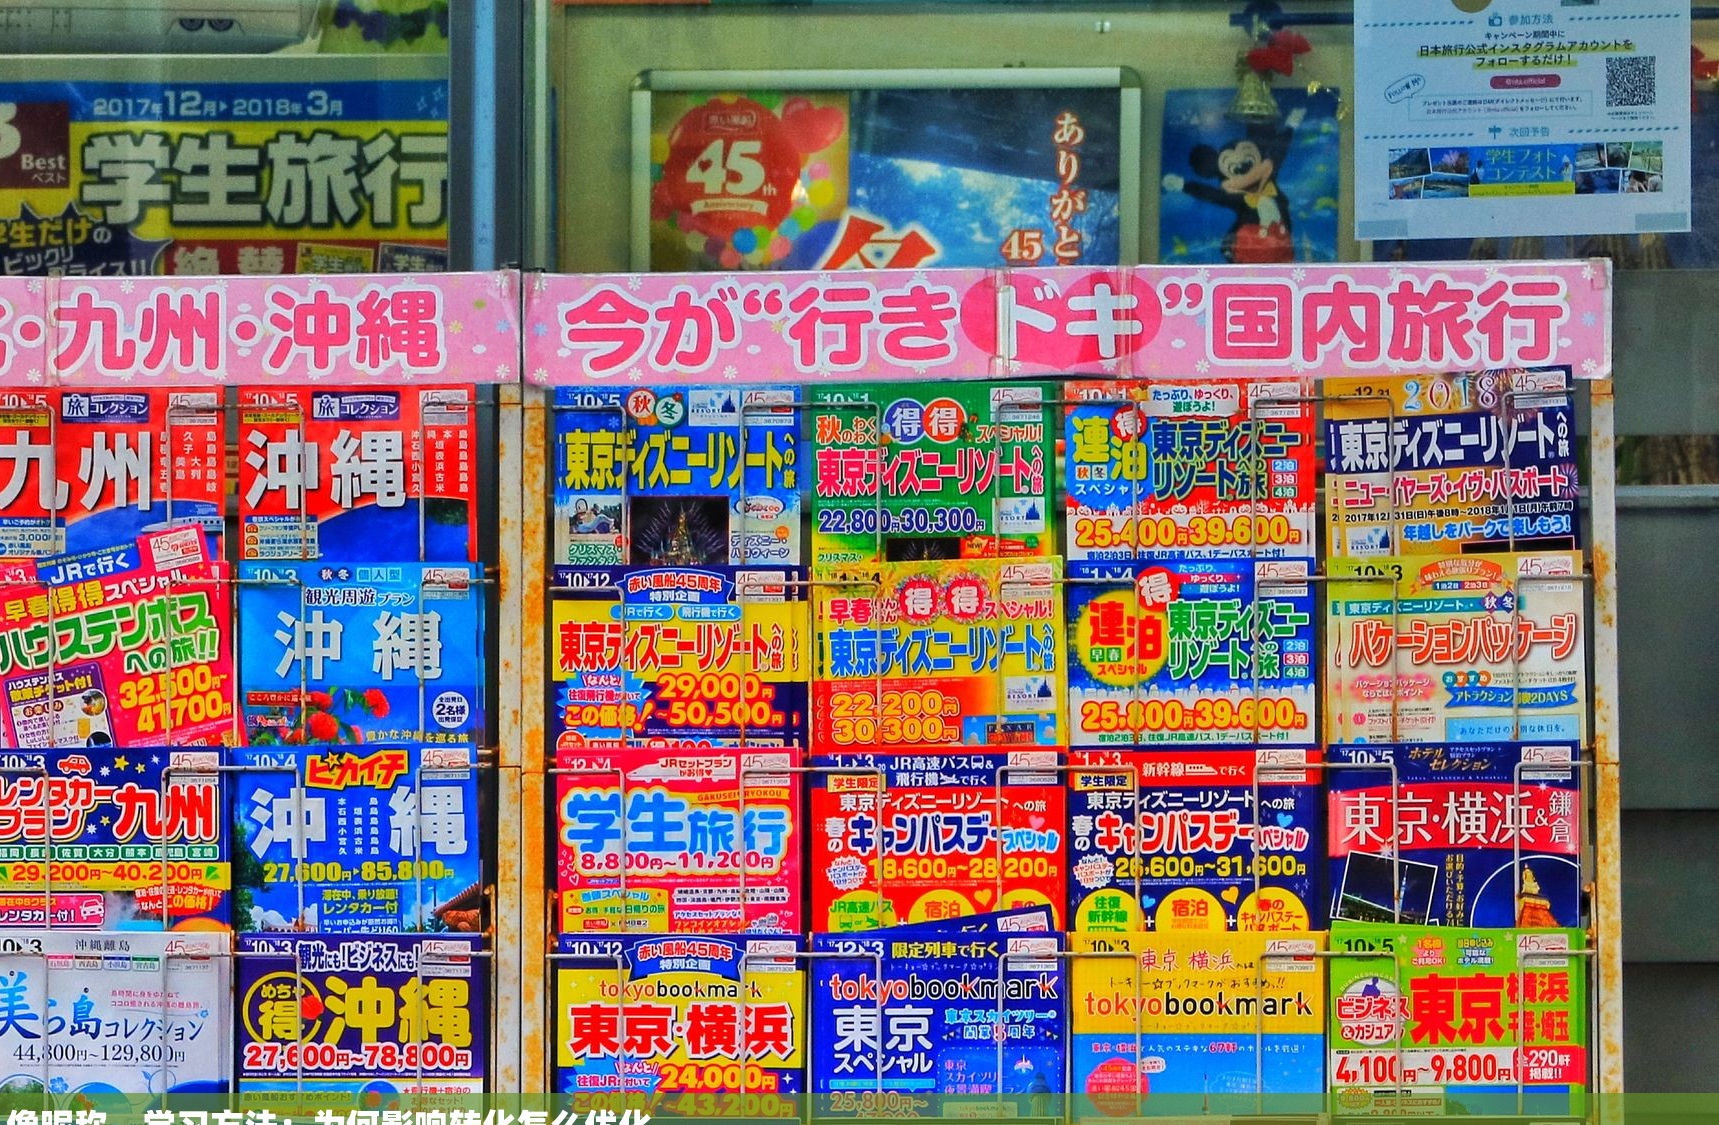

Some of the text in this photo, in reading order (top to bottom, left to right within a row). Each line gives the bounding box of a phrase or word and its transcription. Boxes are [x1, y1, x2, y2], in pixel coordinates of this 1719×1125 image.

[1509, 13, 1554, 25] 参加方法
[1485, 30, 1565, 39] キャンペーン期間中に
[1418, 39, 1633, 57] 日本旅行公式インスタグラムアカウントを
[94, 92, 342, 118] 2017年12月 2018年3月
[1509, 127, 1550, 137] 次回予告
[21, 153, 66, 171] Best
[1486, 148, 1557, 163] 学生フォト
[32, 172, 68, 184] ベスト
[82, 132, 447, 228] 学生旅行
[1487, 165, 1557, 181] コンテスト
[1003, 231, 1043, 260] 45
[4, 246, 75, 275] ビックリ
[1172, 401, 1216, 413] 遊ぼうよ!
[1151, 420, 1301, 459] 東京ディズニー
[245, 430, 407, 510] 沖縄
[564, 430, 783, 491] 東京ディズニーリゾート
[816, 445, 1030, 498] 東京ディズニーリゾート
[1153, 459, 1235, 500] リゾート
[50, 554, 130, 583] JRで行く
[627, 573, 722, 593] 赤い風船45周年
[649, 591, 700, 603] 特別企画
[275, 610, 443, 681] 沖縄
[559, 622, 770, 673] 東京ディズニーリゾート
[1349, 614, 1576, 667] バケーションパッケージ
[658, 673, 774, 700] 29,000円
[305, 751, 409, 790] ピカイチ
[660, 756, 734, 770] JRセットプラン
[1428, 756, 1494, 772] セレクション
[744, 789, 781, 797] RYOKOU
[833, 777, 880, 790] 学生限定
[113, 783, 220, 842] 九州
[250, 786, 468, 859] 沖縄
[564, 791, 787, 853] 学生旅行
[323, 902, 398, 915] レンタカー付
[1089, 910, 1128, 923] 新幹線
[74, 938, 131, 952] 沖縄離島
[891, 941, 1000, 959] 限定列車で行く
[324, 975, 473, 1049] 沖縄
[1336, 996, 1410, 1020] ビジネス
[1410, 973, 1505, 1045] 東京
[569, 1003, 795, 1061] 東京・横浜
[833, 1006, 935, 1054] 東京
